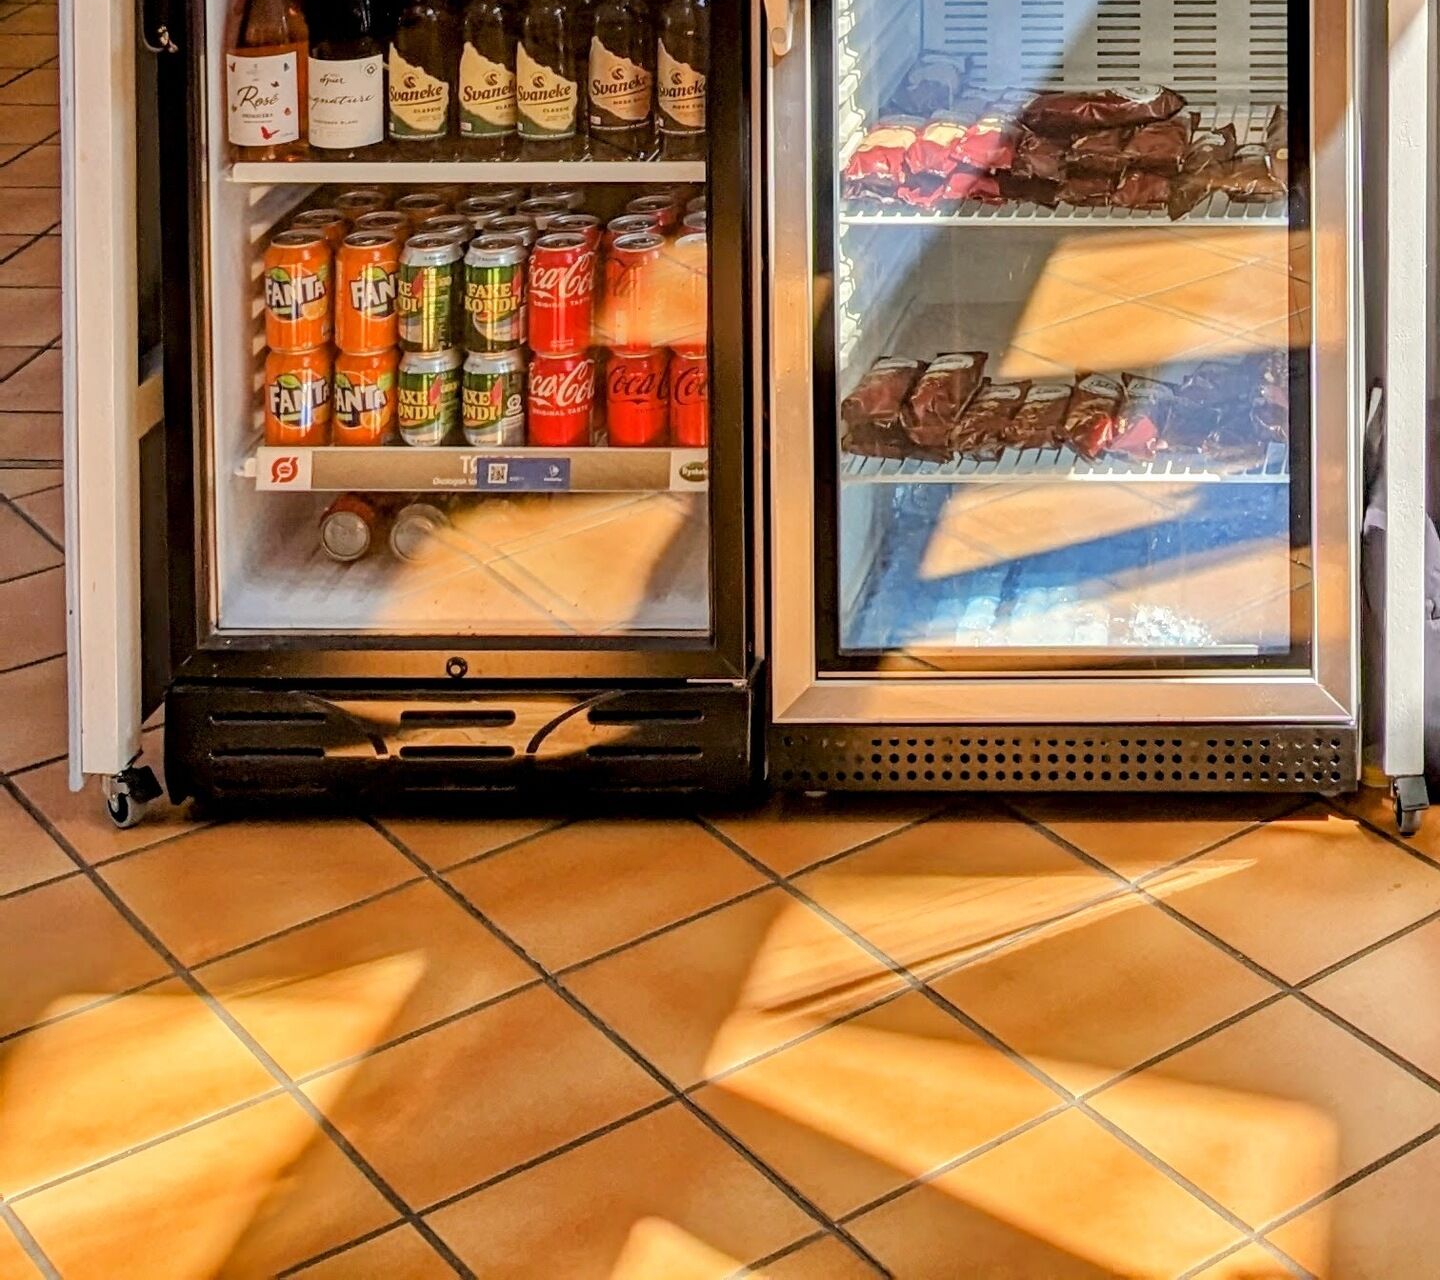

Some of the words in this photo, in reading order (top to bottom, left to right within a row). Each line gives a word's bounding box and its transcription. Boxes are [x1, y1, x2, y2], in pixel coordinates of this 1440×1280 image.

[390, 84, 443, 101] Svaneke
[518, 84, 571, 101] Svaneke
[265, 274, 326, 307] FANTA
[468, 283, 511, 296] FAXE
[464, 297, 518, 313] KONDI
